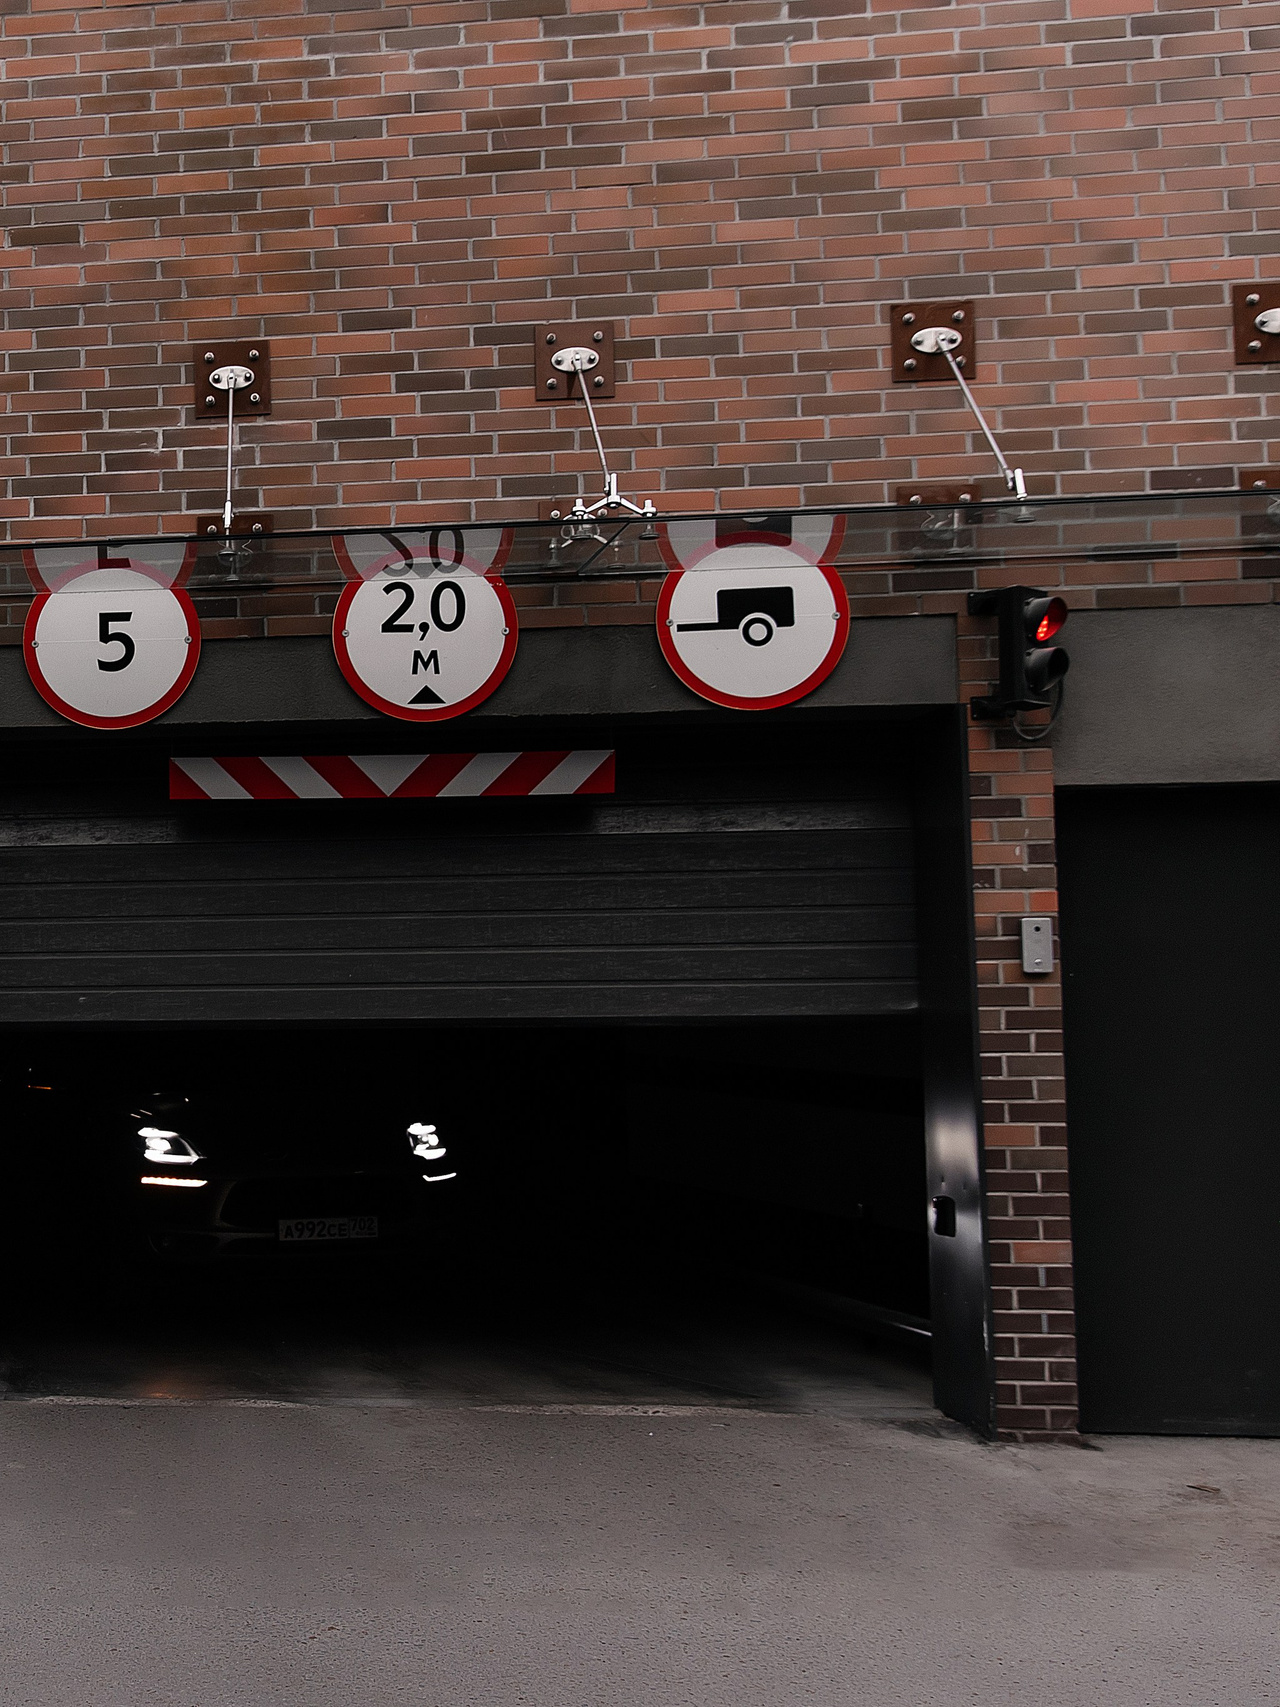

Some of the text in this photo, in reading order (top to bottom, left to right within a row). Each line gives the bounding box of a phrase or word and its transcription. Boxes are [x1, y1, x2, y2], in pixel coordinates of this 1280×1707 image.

[97, 611, 136, 673] 5
[381, 580, 466, 642] 2,0
[351, 1217, 375, 1232] 702
